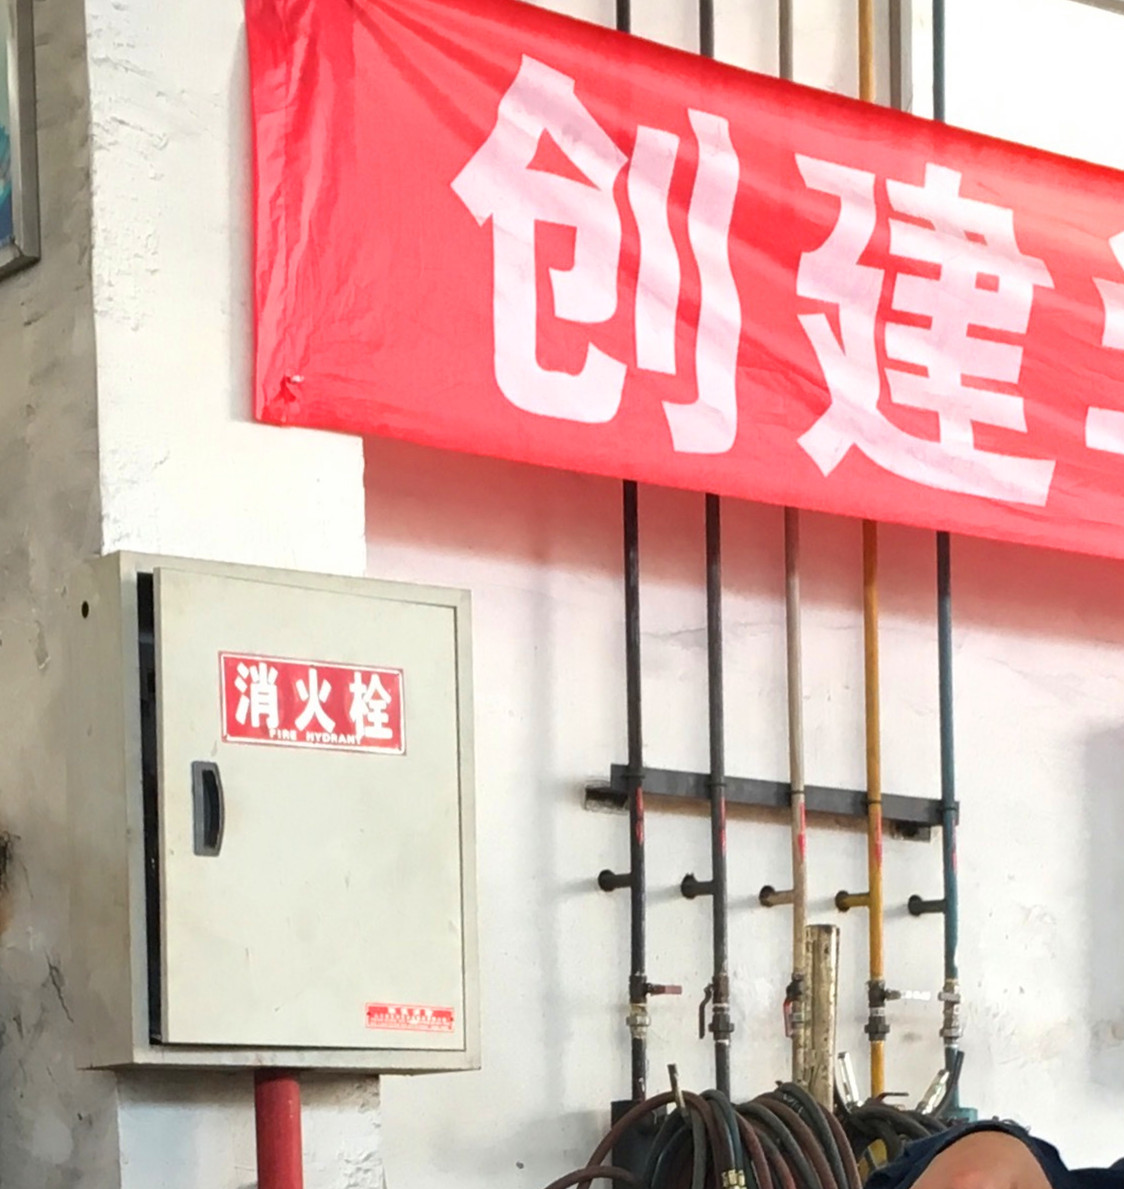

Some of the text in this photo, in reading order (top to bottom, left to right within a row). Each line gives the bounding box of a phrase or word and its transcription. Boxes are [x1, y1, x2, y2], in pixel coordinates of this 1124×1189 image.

[234, 661, 394, 740] 消火栓
[269, 727, 361, 745] FIRE HYDRANT
